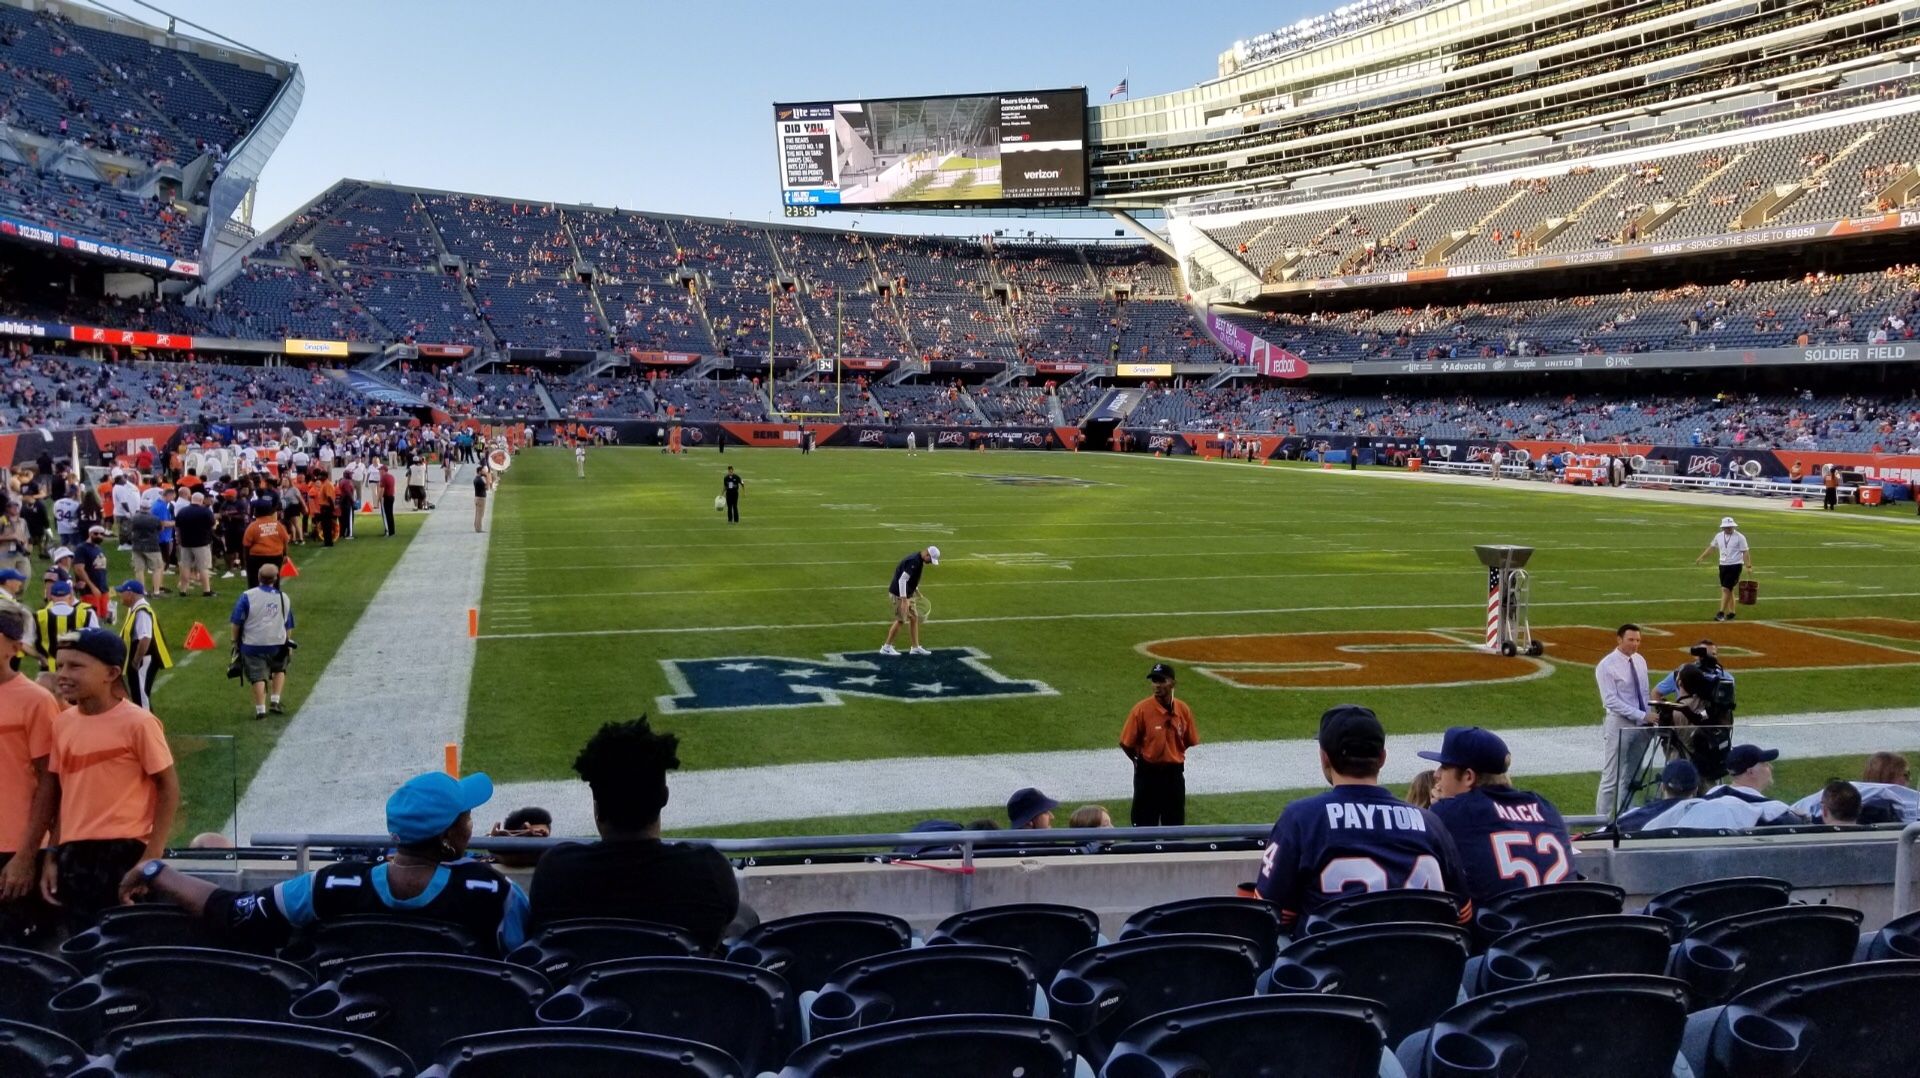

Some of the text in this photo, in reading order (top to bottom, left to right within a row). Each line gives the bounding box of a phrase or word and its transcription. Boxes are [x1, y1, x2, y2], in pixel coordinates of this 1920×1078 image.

[784, 124, 801, 133] DID
[804, 123, 823, 133] YOU
[1023, 169, 1059, 179] verizon
[786, 205, 815, 217] 23:58
[1686, 238, 1724, 250] <SPACE>
[1724, 235, 1742, 246] THE
[1744, 232, 1770, 243] ISSUE
[1771, 230, 1784, 241] TO
[1785, 226, 1816, 238] 69050
[145, 254, 152, 264] TO
[1565, 251, 1614, 264] 312.235.7999
[1446, 259, 1535, 278] ABLE FAN BEHAVIOR
[1354, 272, 1408, 286] HELP STOP UN
[1215, 317, 1238, 338] BEST DEAL
[1804, 346, 1906, 362] SOLDIER FIELD
[818, 361, 831, 371] 34
[1273, 354, 1295, 373] redbox
[1449, 362, 1486, 371] Advocate
[1615, 357, 1633, 367] PNC
[1862, 490, 1870, 499] G
[57, 509, 72, 522] 34
[1326, 803, 1426, 832] PAYTON
[1490, 830, 1570, 888] 52
[105, 1004, 137, 1015] verizon
[345, 1011, 376, 1022] verizon
